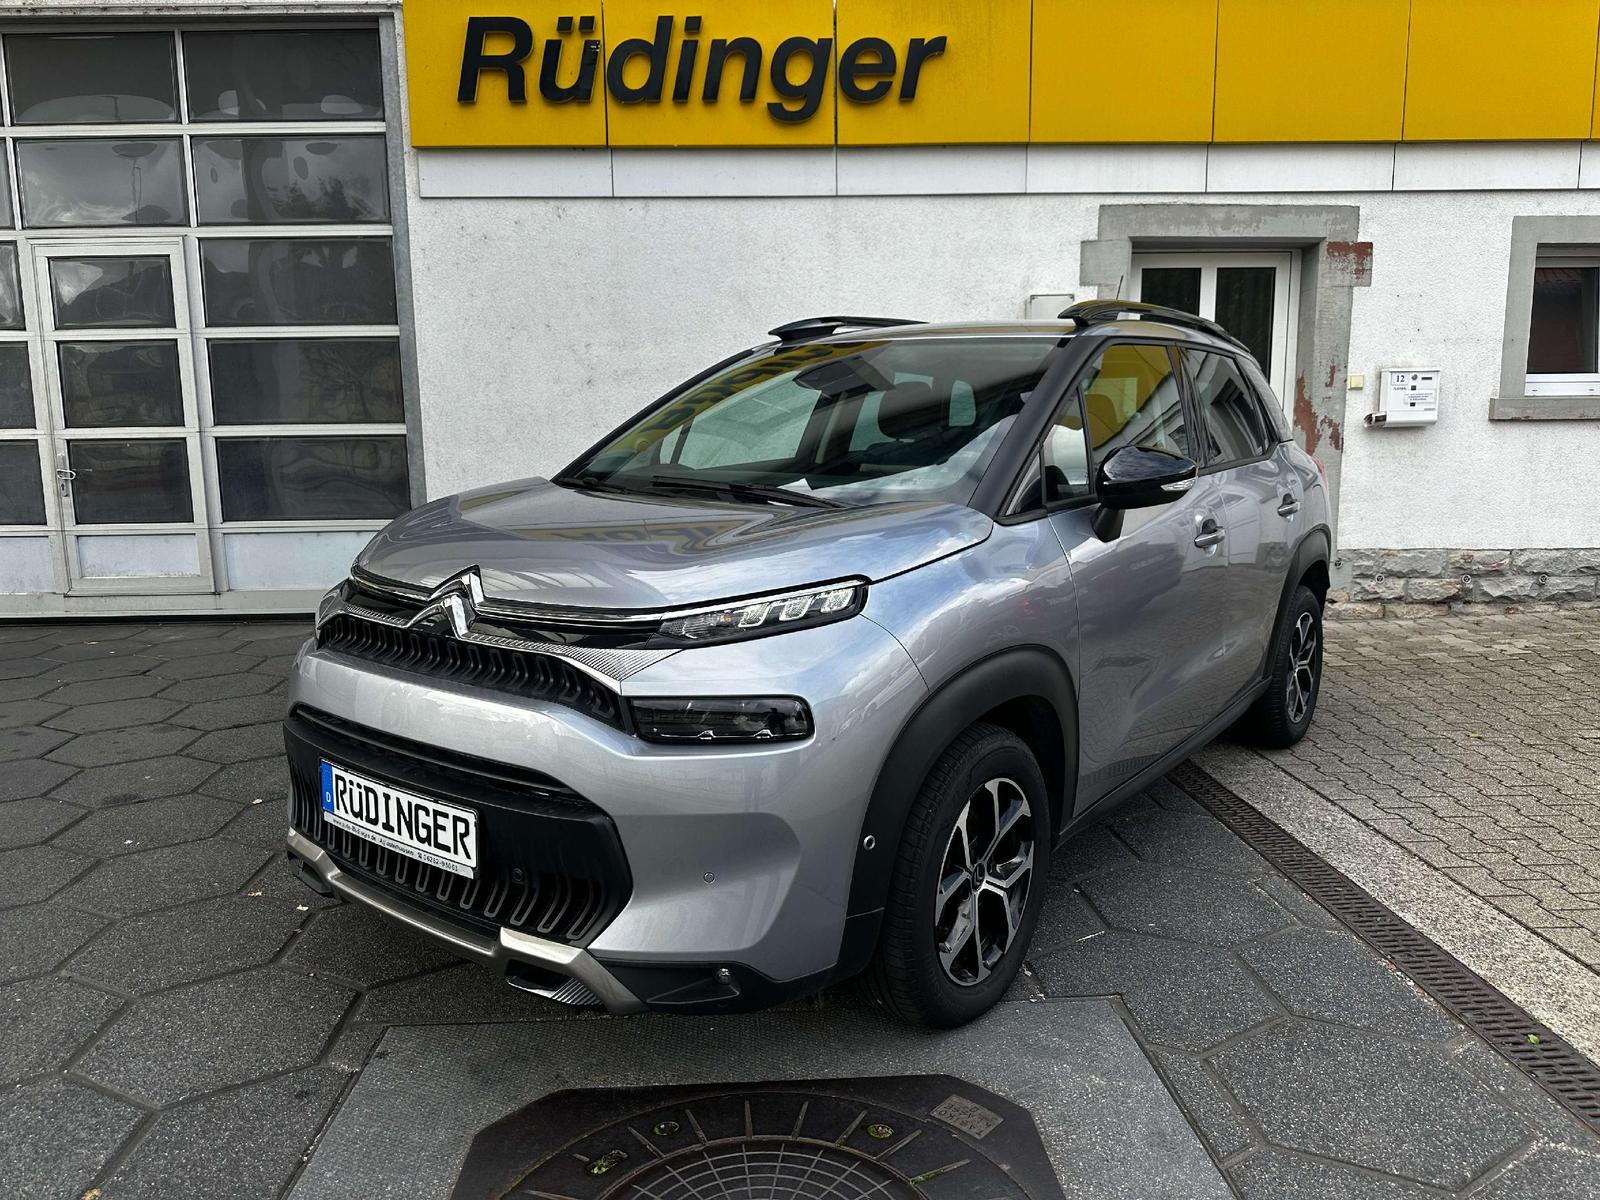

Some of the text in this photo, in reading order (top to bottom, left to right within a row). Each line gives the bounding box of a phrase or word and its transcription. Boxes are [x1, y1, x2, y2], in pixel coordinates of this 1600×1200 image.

[457, 15, 947, 124] Rüdinger
[1396, 375, 1405, 383] 12
[334, 773, 472, 860] RÜDINGER
